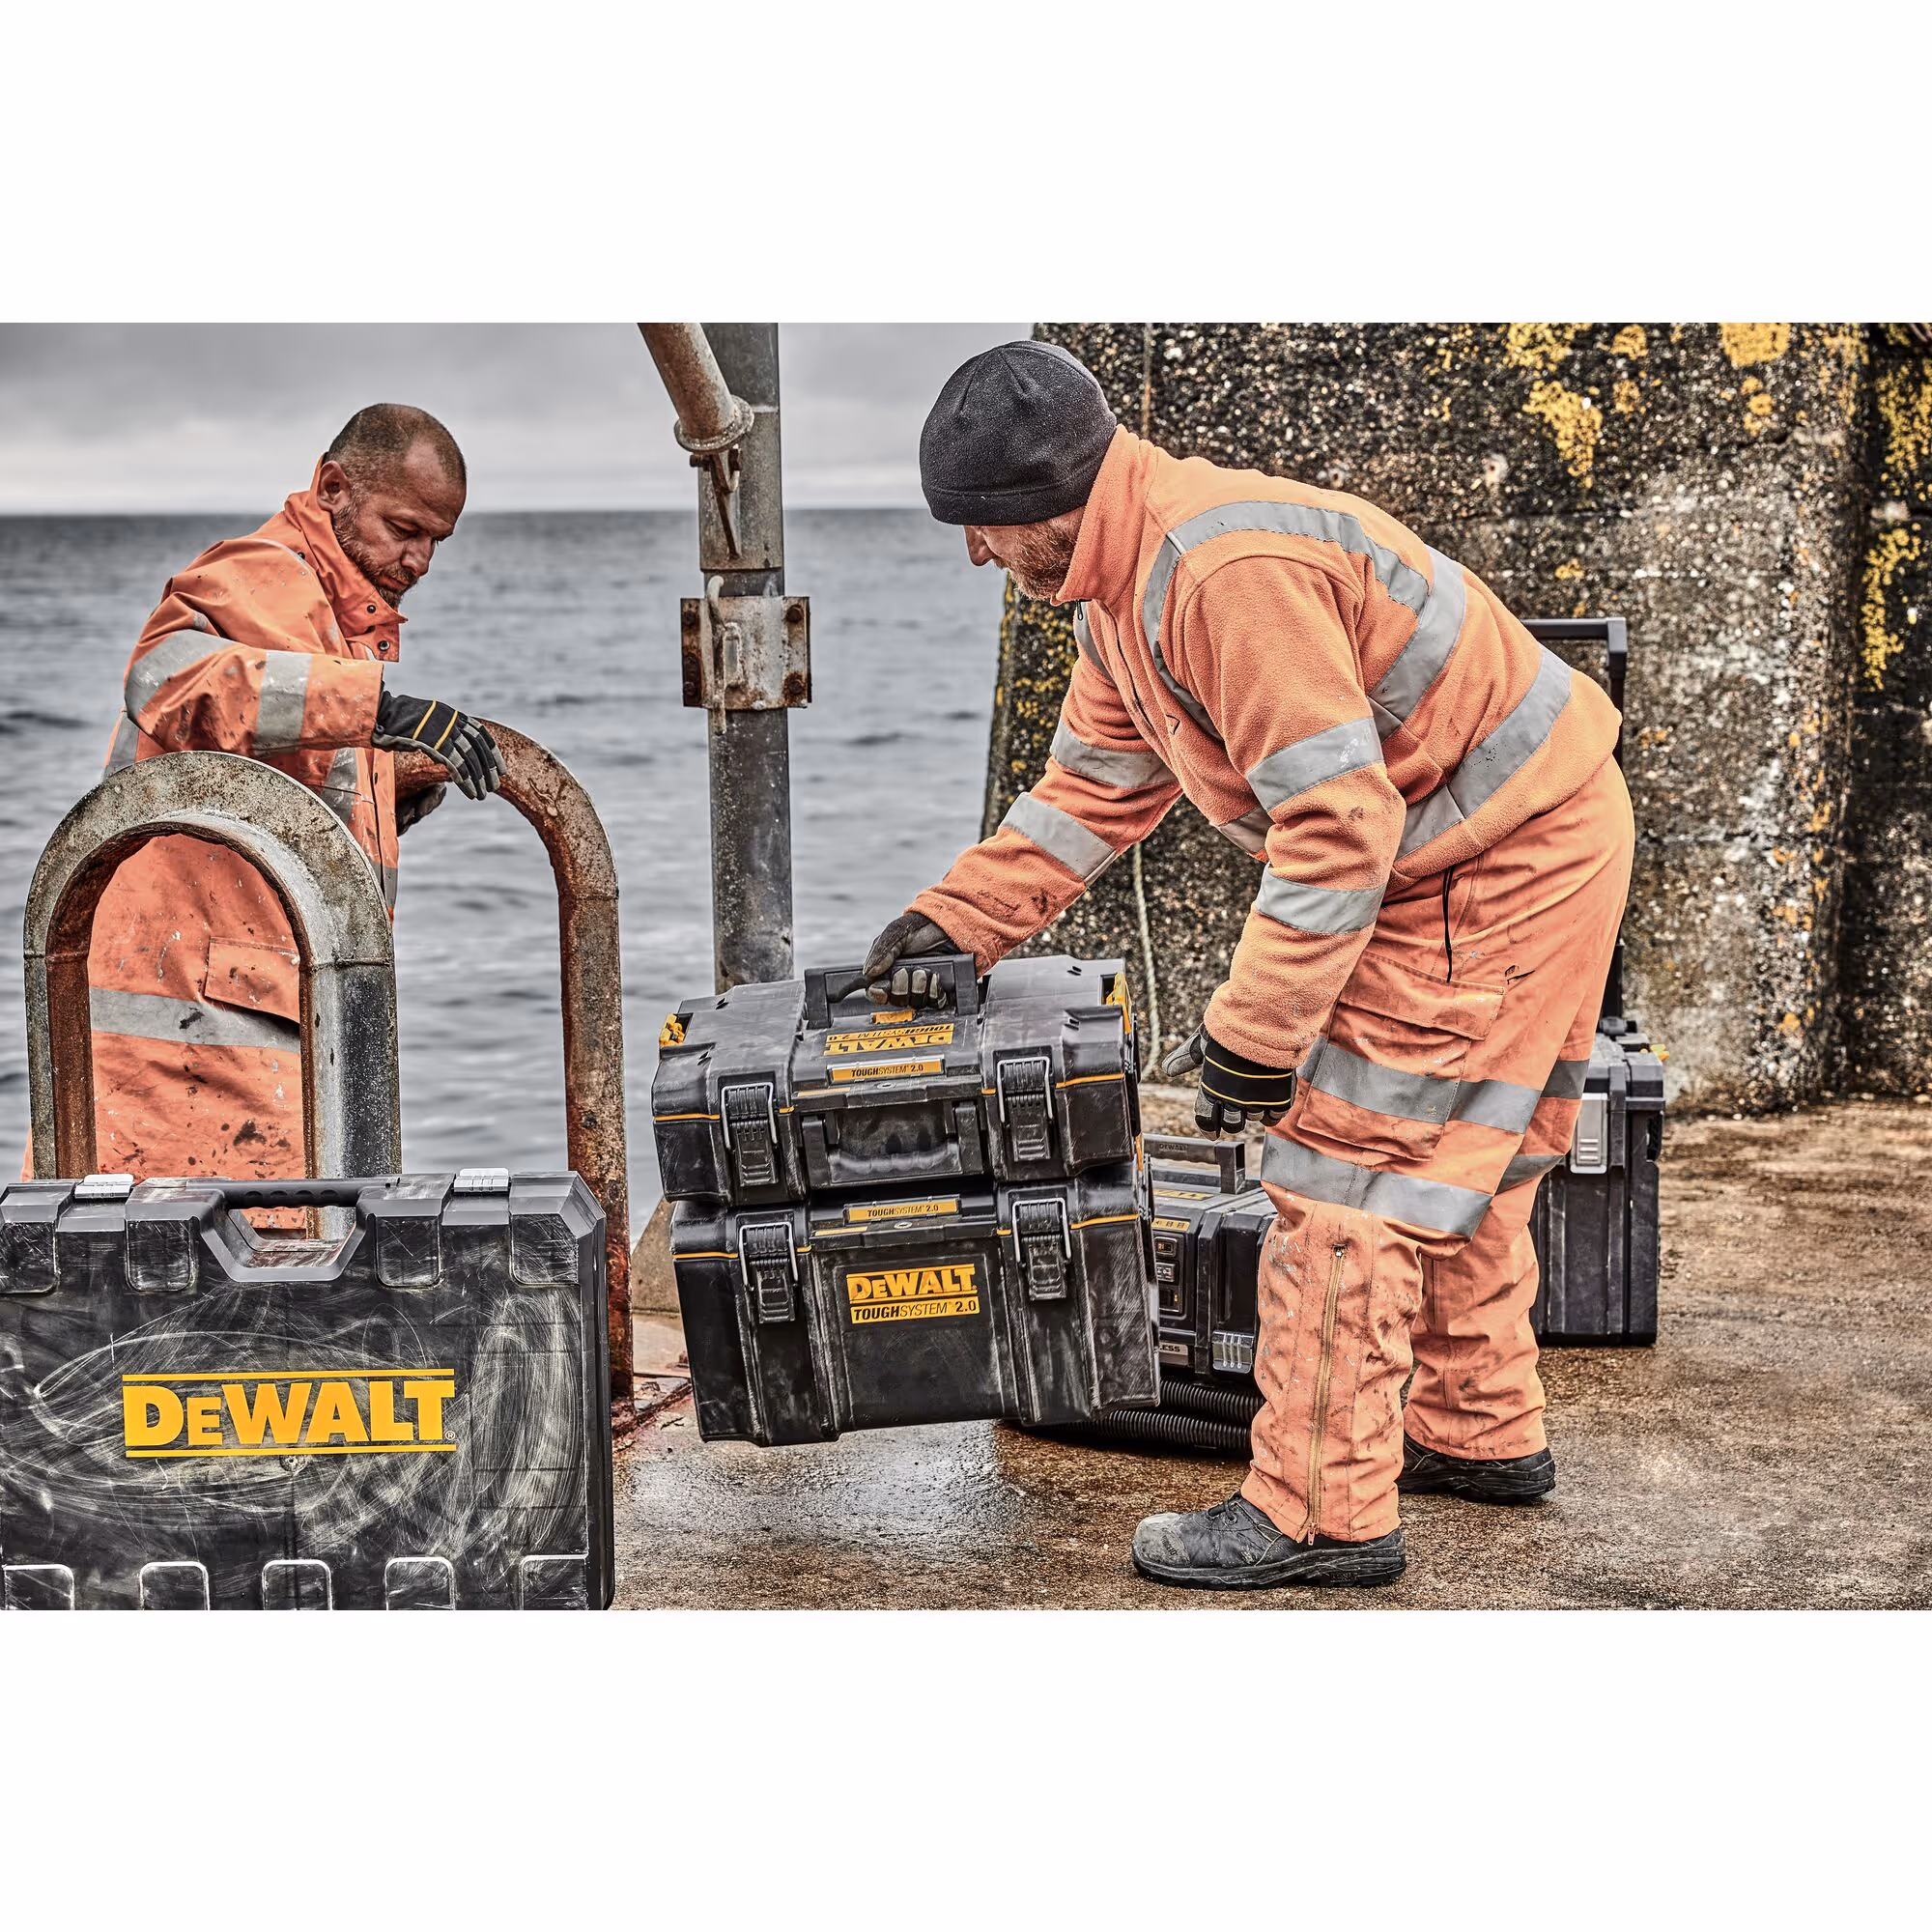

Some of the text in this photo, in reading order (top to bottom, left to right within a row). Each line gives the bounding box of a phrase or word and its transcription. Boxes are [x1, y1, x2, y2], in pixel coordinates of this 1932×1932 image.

[851, 1064, 924, 1078] TOUGHSYSTEM 2.0
[867, 1204, 939, 1217] TOUGHSYSTEM 2.0
[854, 1299, 977, 1321] TOUGHSYSTEM 2.0
